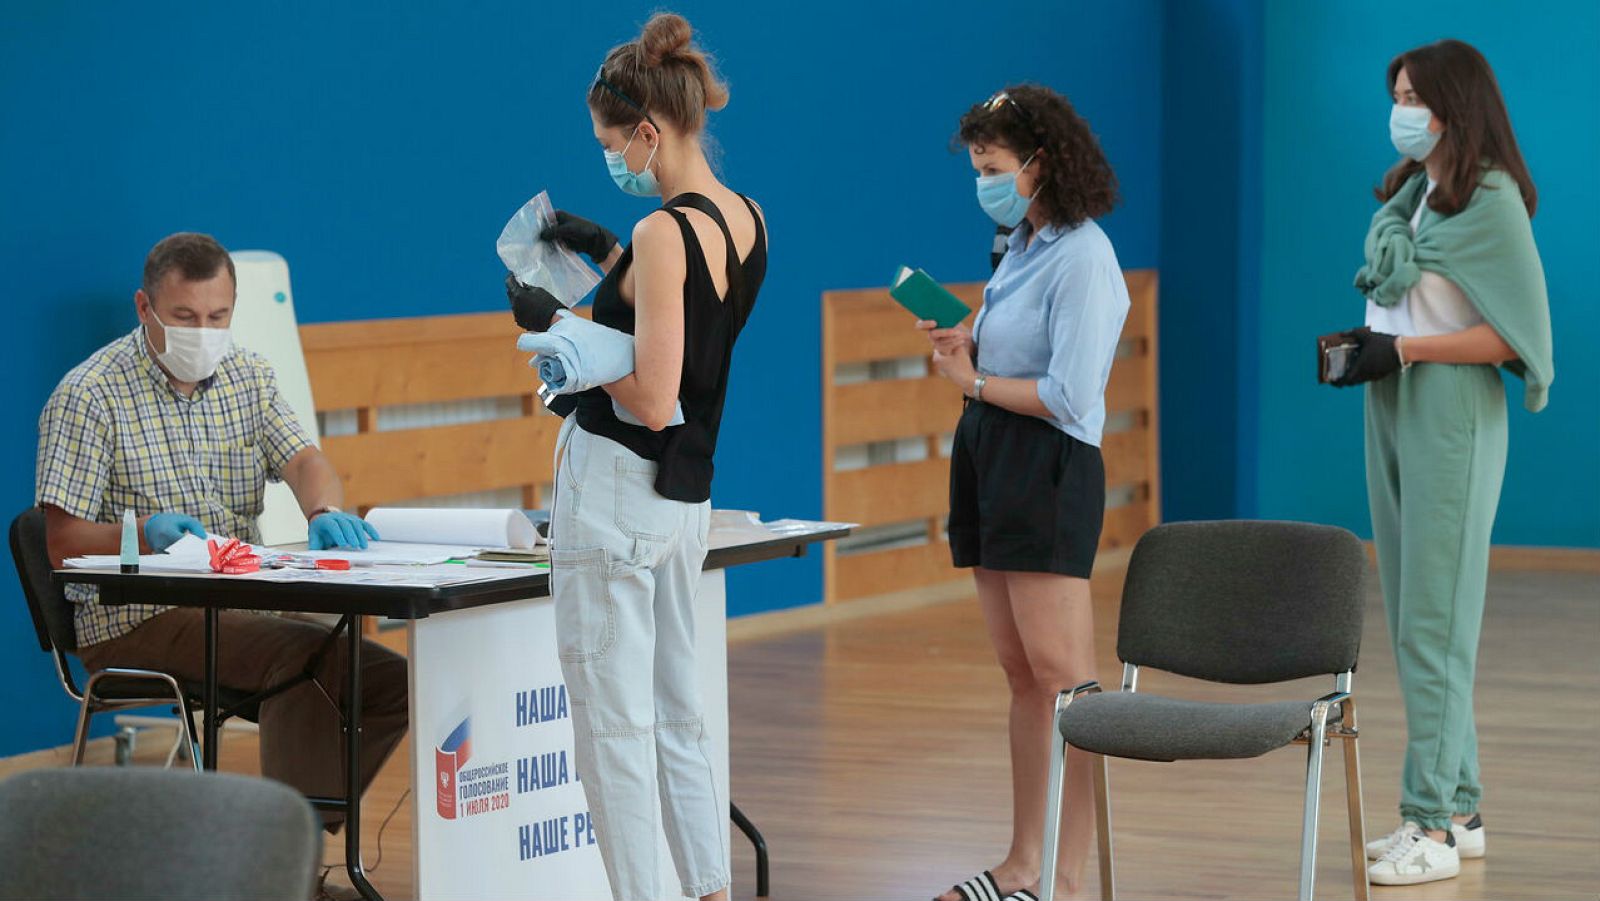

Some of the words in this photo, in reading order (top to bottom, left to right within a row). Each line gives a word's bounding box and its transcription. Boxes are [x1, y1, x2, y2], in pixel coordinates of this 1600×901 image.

[516, 684, 568, 727] НАША
[459, 762, 508, 782] ОБЩЕРОССИЙСКОЕ
[460, 776, 509, 800] ГОЛОСОВАНИЕ
[517, 750, 568, 794] НАША
[466, 797, 489, 817] ИЮЛЯ
[491, 793, 509, 811] 2020
[519, 816, 569, 861] НАШЕ
